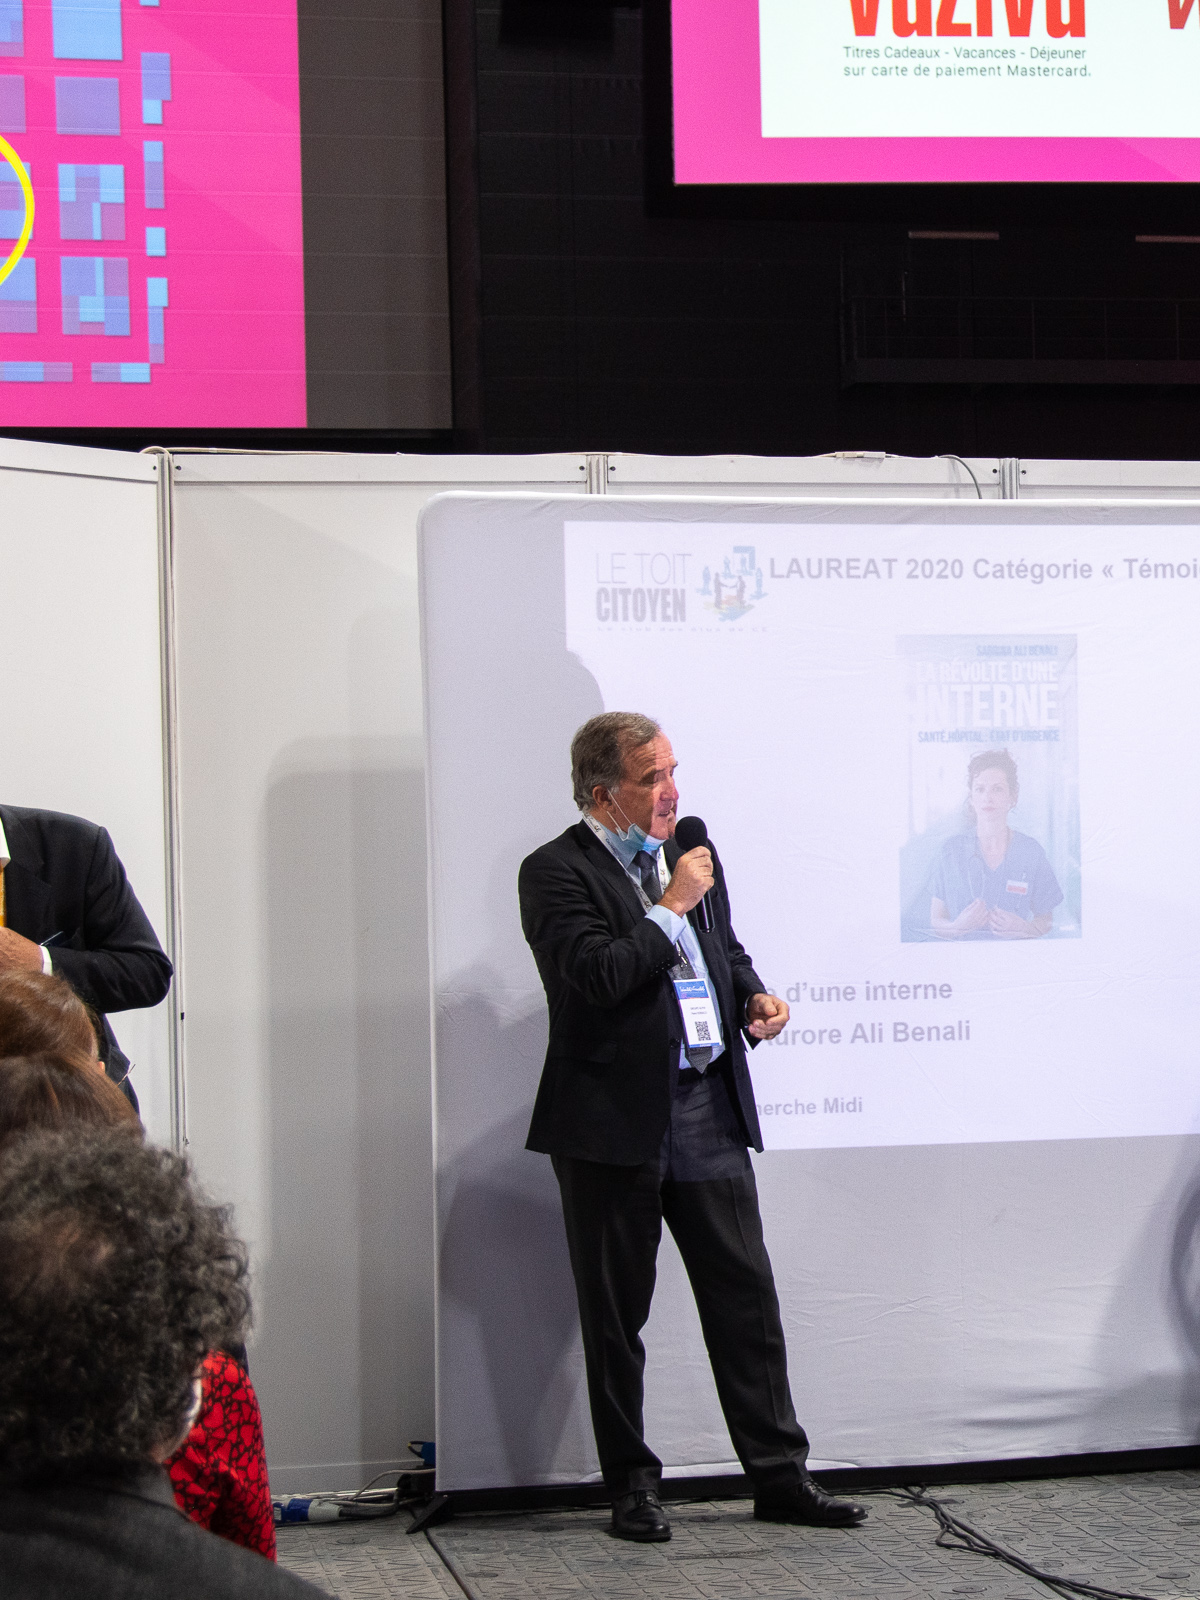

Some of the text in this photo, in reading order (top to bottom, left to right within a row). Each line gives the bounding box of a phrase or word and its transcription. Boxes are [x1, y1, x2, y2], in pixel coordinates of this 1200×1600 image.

[843, 46, 880, 59] Titres
[884, 46, 941, 59] Cadeaux
[954, 46, 1016, 60] Vacances
[1030, 46, 1087, 62] Déjeuner
[844, 64, 1092, 79] sur carte de paiement Mastercard.
[596, 552, 692, 585] LE TOIT
[770, 557, 898, 580] LAUREAT
[906, 558, 964, 580] 2020
[972, 557, 1093, 585] Catégorie
[596, 587, 687, 623] CITOYEN
[915, 684, 1060, 728] INTERNE
[786, 982, 856, 1003] d'une
[865, 981, 953, 1002] interne
[765, 1020, 971, 1046] urore Ali Benali
[823, 1097, 863, 1114] Midi
